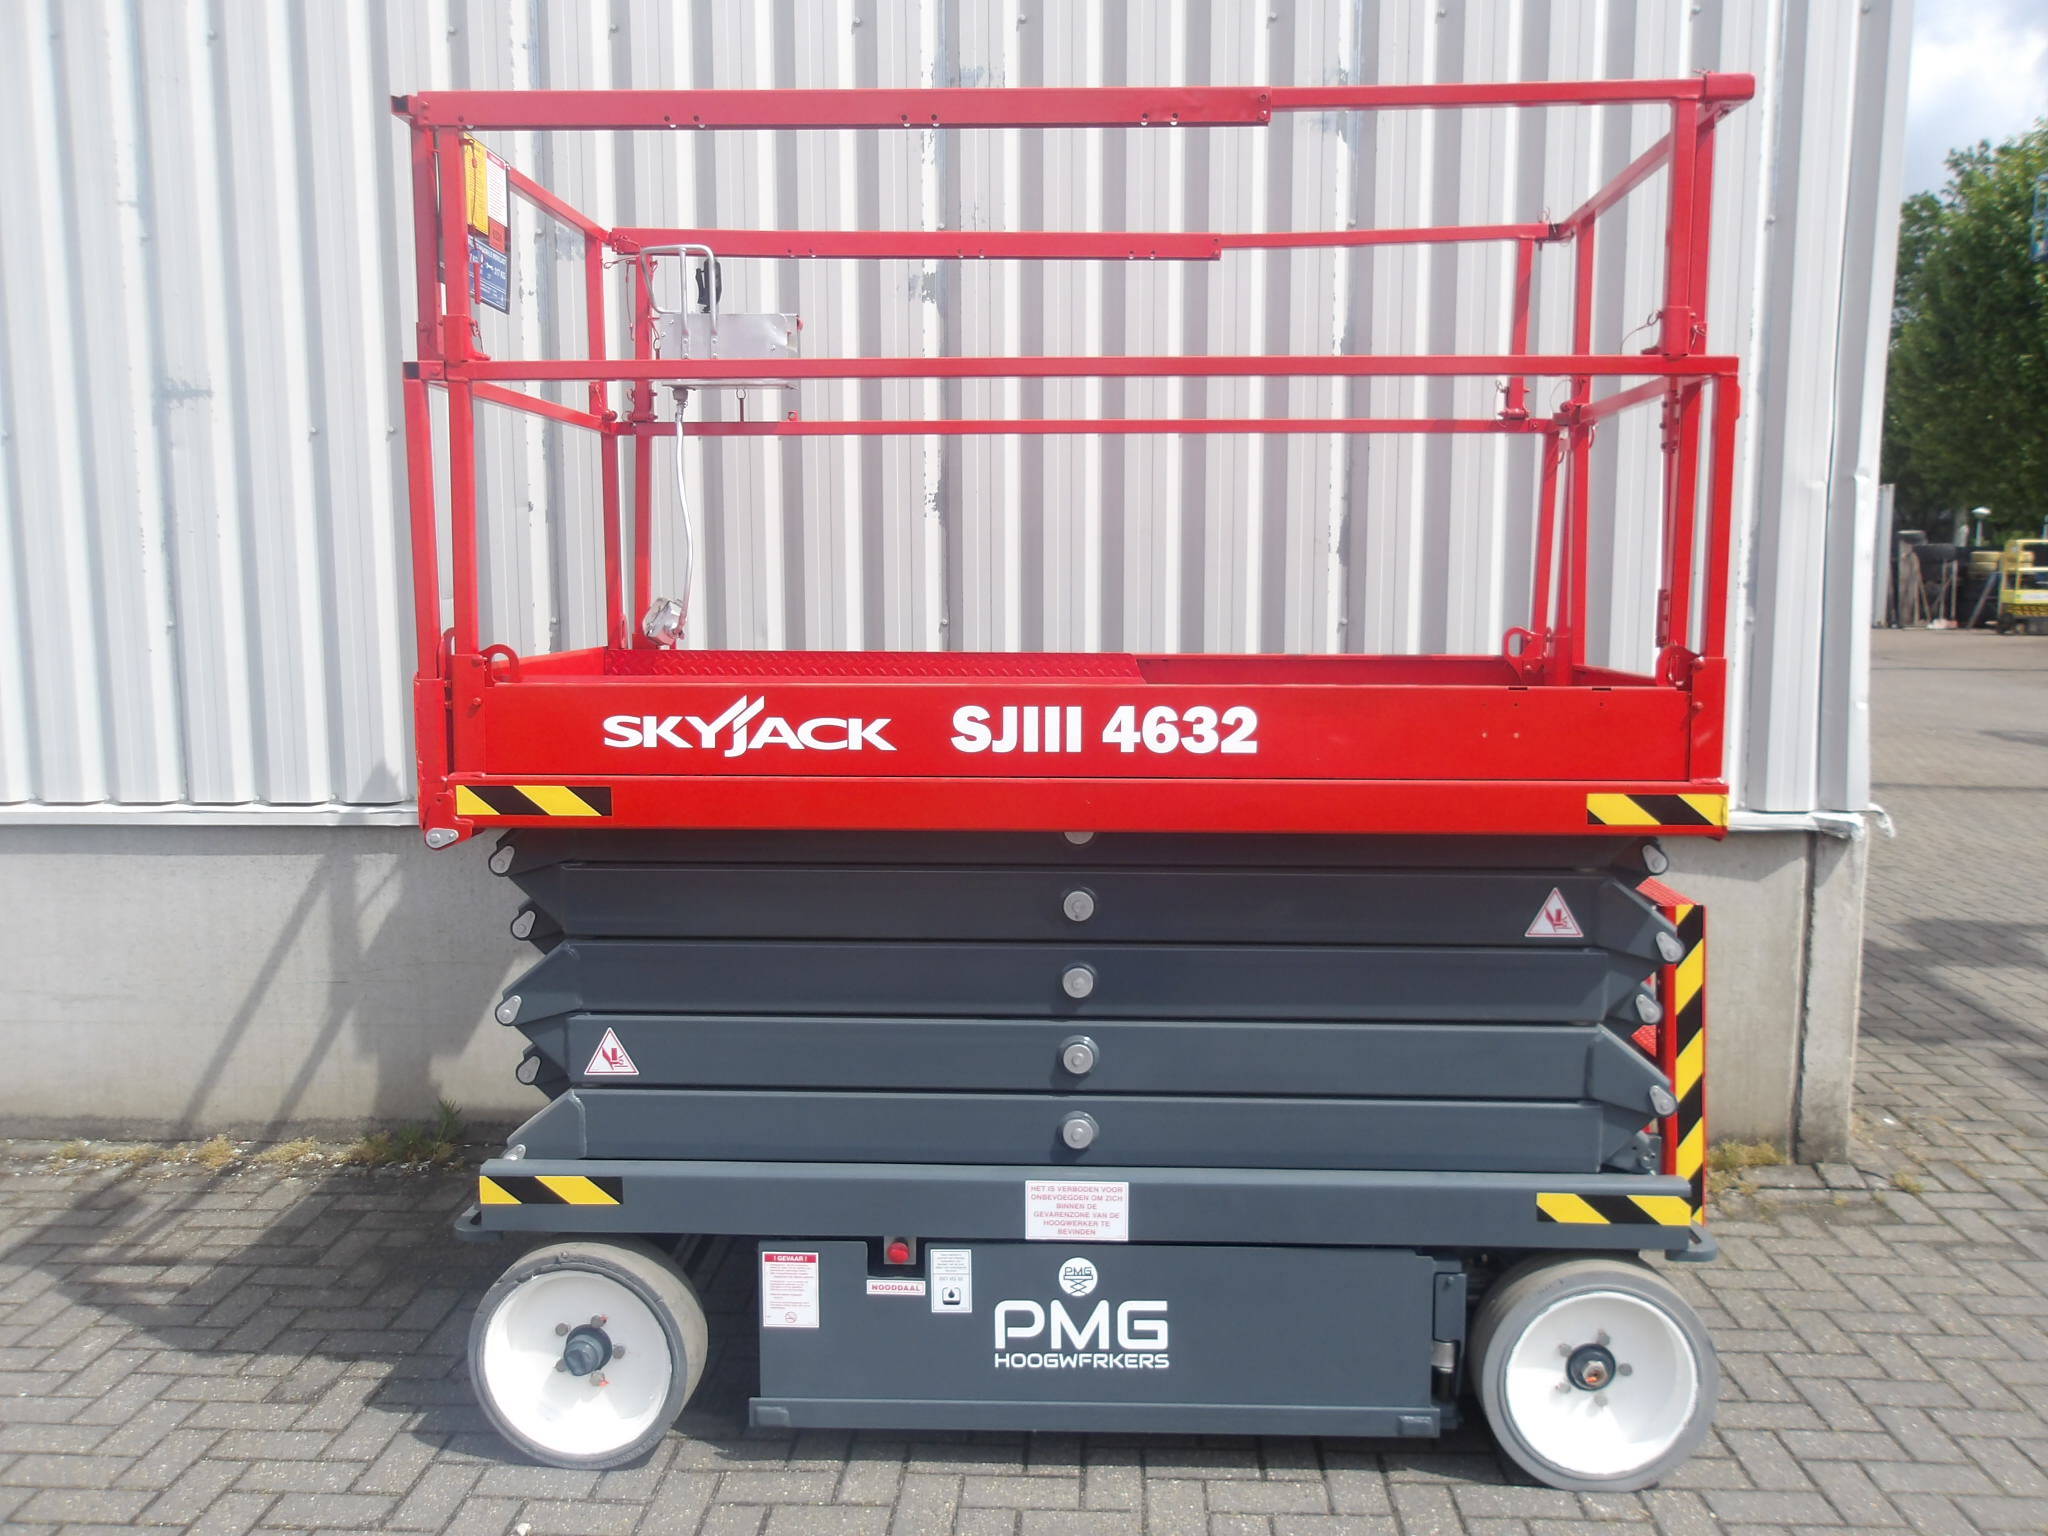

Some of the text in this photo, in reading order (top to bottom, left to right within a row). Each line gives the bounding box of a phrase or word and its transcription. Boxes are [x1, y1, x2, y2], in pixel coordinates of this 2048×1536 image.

[602, 694, 898, 758] SKYJACK
[950, 705, 1258, 753] SJIII 4632
[871, 1284, 921, 1292] NOODDAAL
[1064, 1266, 1092, 1276] PMG
[994, 1299, 1169, 1350] PMG
